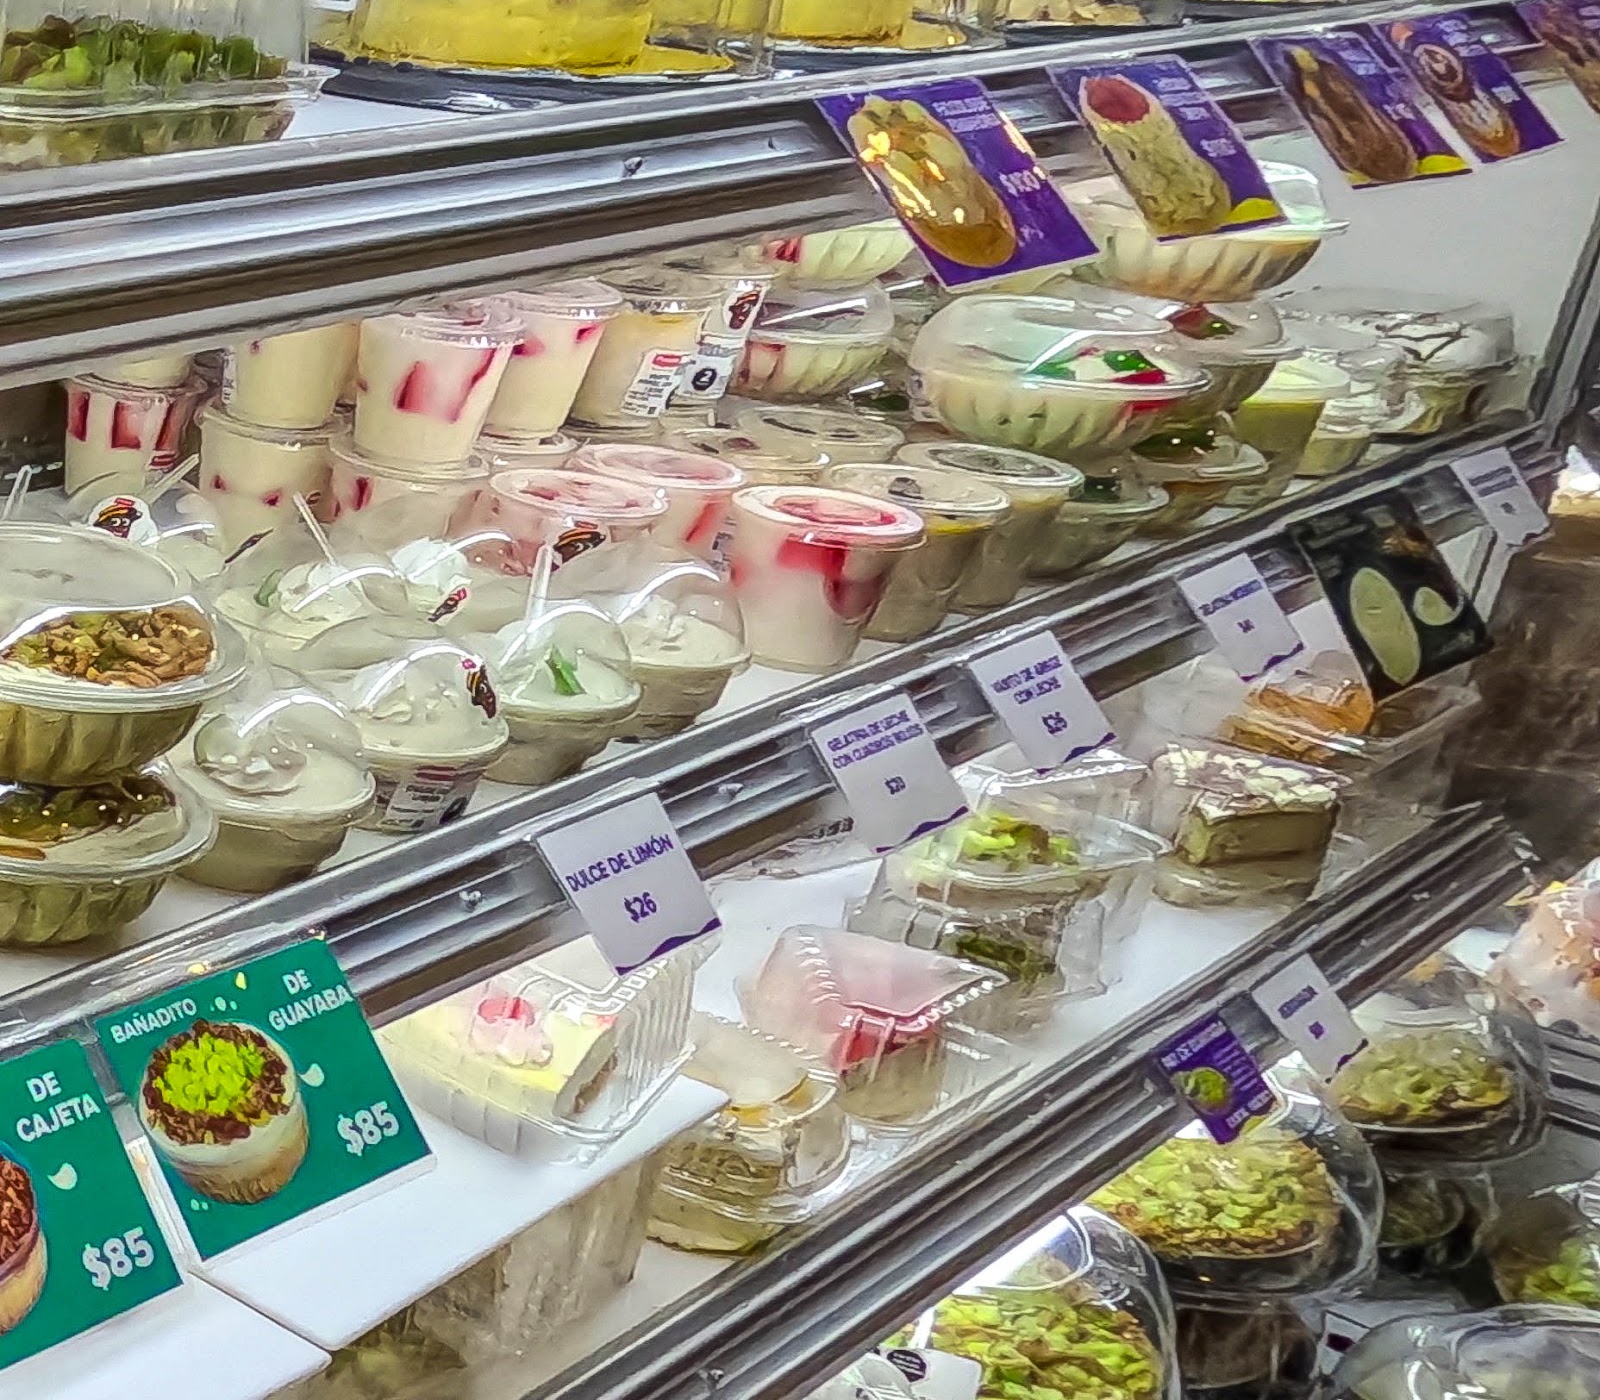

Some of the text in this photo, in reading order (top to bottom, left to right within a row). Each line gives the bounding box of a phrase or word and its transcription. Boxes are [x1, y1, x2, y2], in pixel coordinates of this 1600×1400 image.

[565, 833, 675, 892] DULCE DE LIMÓN
[623, 891, 657, 924] $26
[280, 968, 312, 994] DE
[110, 997, 197, 1045] BAÑADITO
[267, 983, 354, 1032] GUAYABA
[25, 1070, 60, 1102] DE
[15, 1091, 102, 1144] CAJETA
[336, 1100, 400, 1157] $85
[81, 1226, 154, 1292] $85
